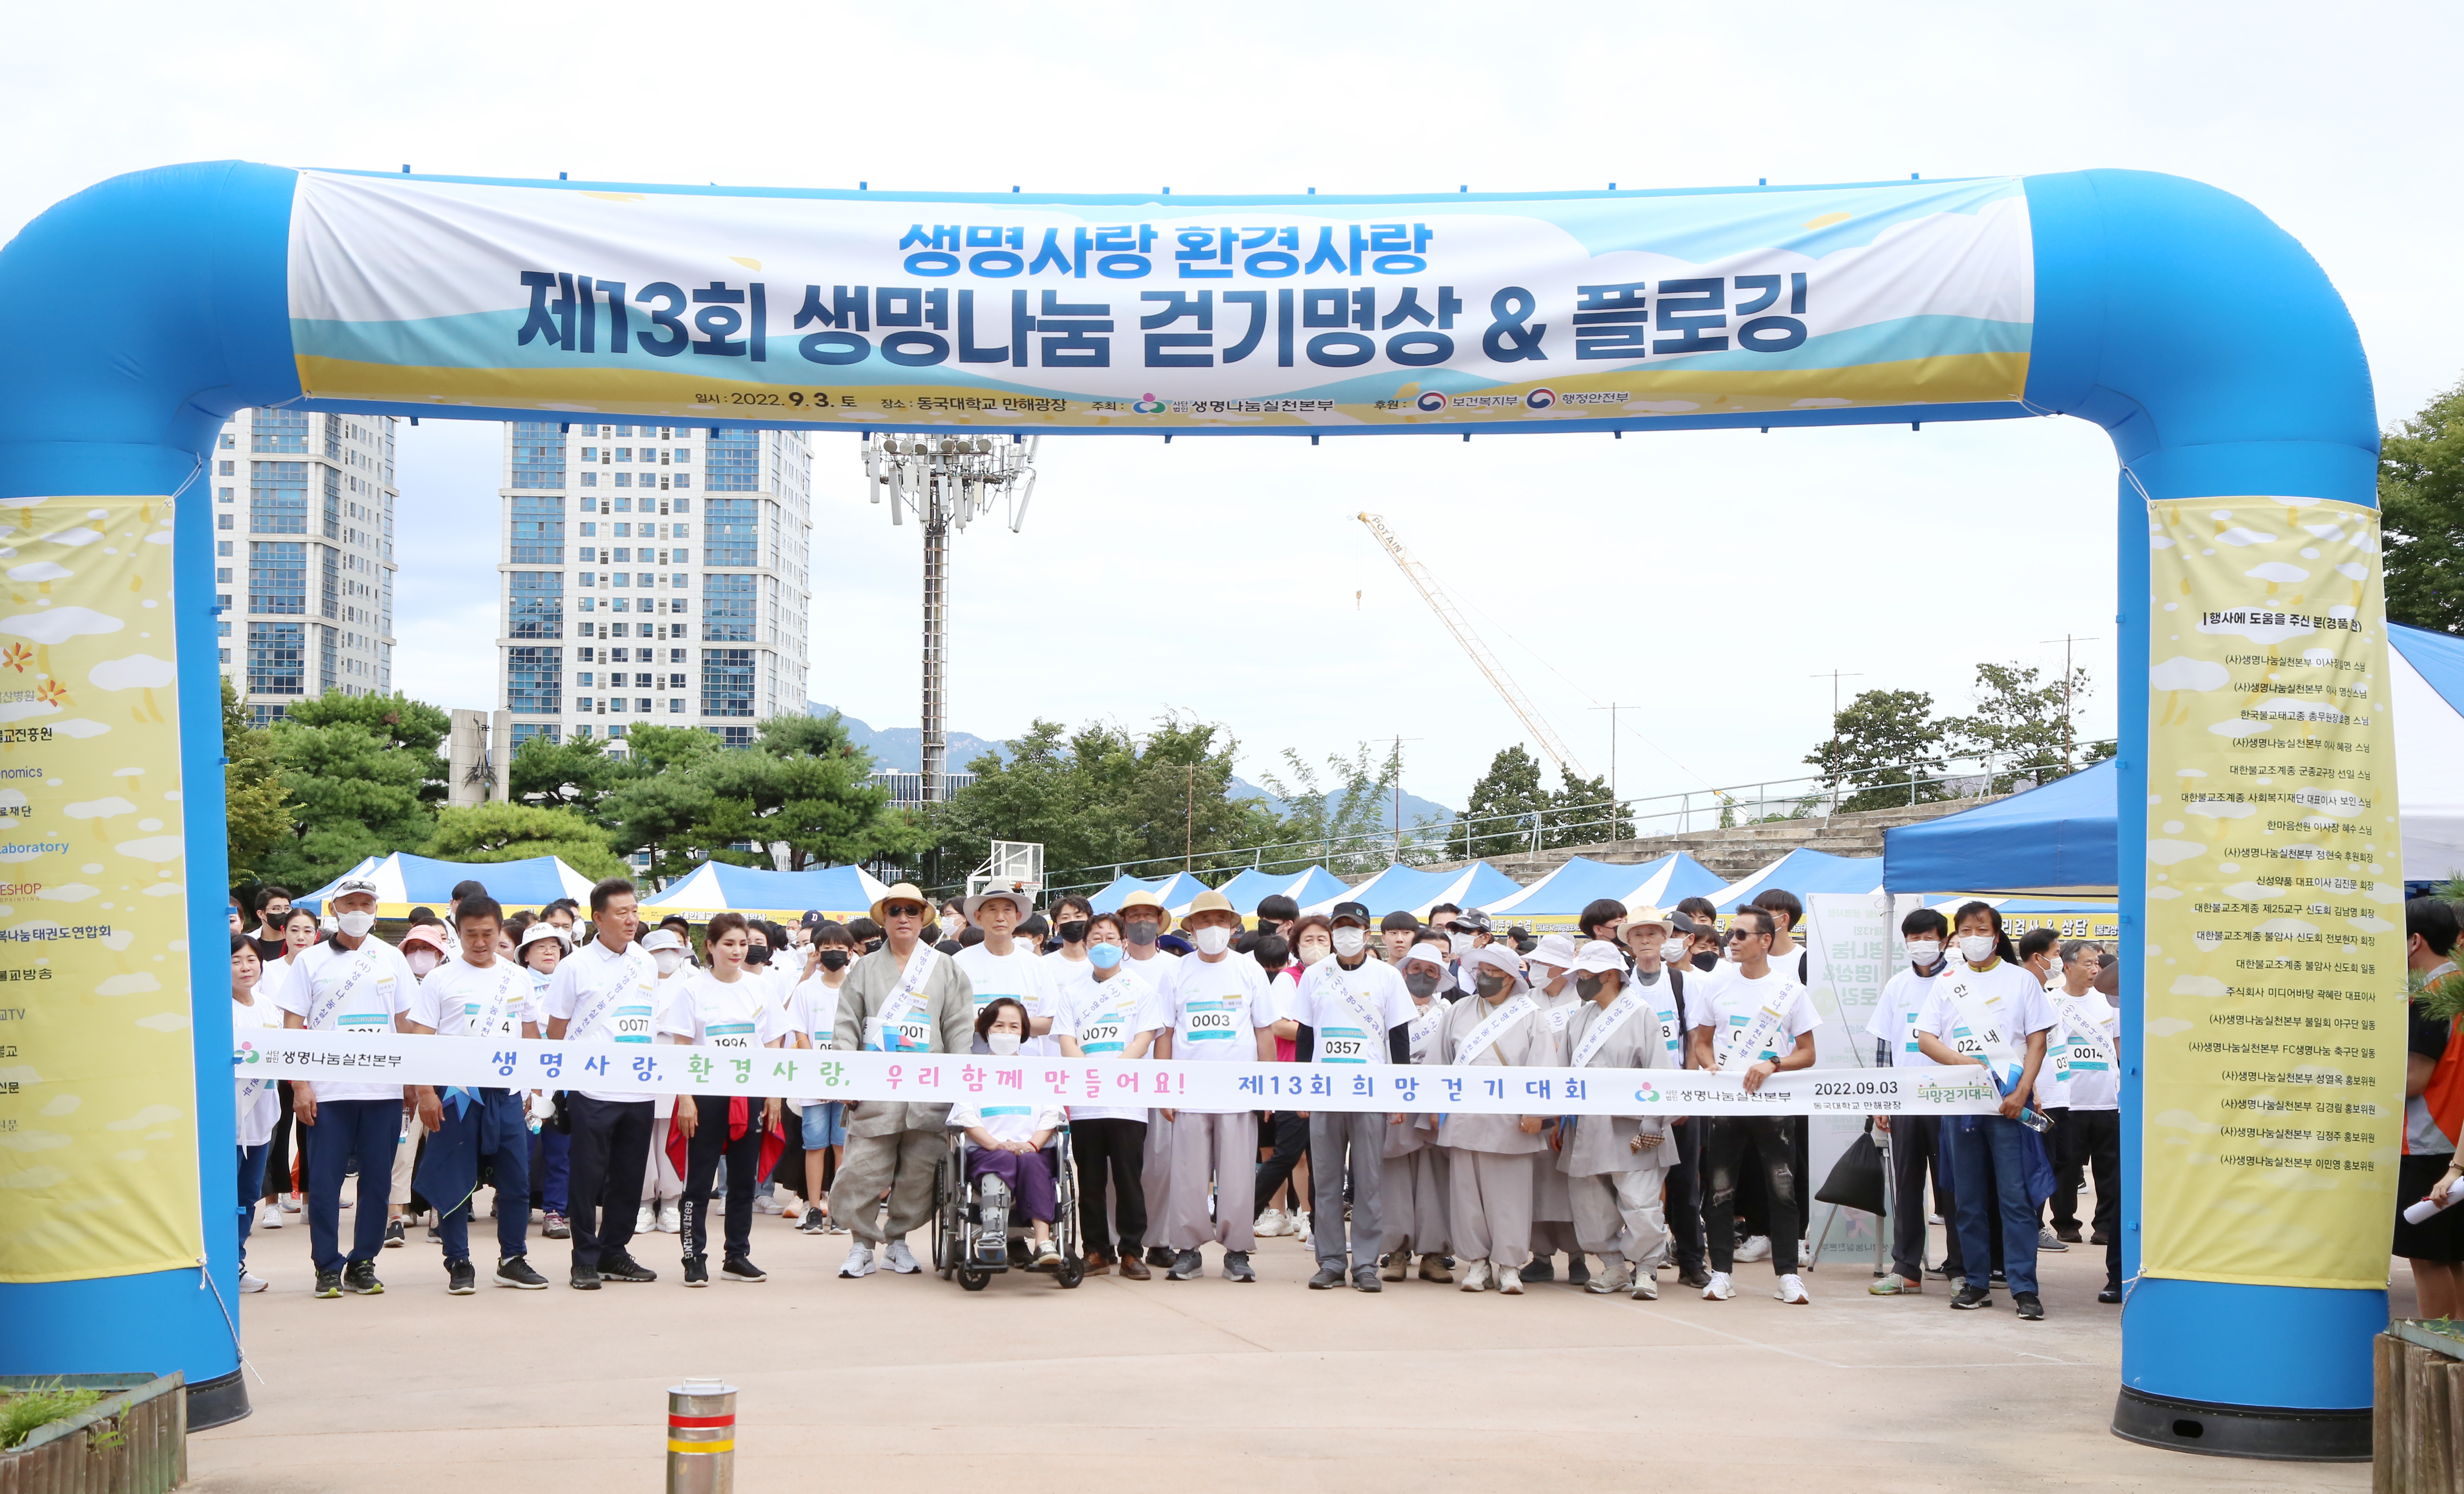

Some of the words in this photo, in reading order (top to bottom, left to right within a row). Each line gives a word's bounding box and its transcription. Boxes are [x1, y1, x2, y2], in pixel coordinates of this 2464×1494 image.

[899, 224, 1158, 279] 생명사랑
[1175, 223, 1433, 279] 환경사랑
[517, 270, 766, 362] 제13회
[793, 285, 1114, 368] 생명나눔
[1140, 286, 1463, 368] 걷기명상
[1482, 286, 1549, 363] &
[1572, 272, 1807, 360] 플로깅
[842, 396, 857, 407] 토
[917, 397, 998, 411] 동국대학교
[1002, 398, 1067, 412] 만해광장
[1192, 400, 1333, 413] 생명나눔실천본부
[1452, 396, 1517, 407] 보건복지부
[1562, 393, 1628, 404] 행정안전부
[1372, 517, 1403, 553] POTAIN
[2210, 612, 2246, 624] 행사에
[2250, 613, 2286, 625] 도움을
[2289, 614, 2310, 627] 주신
[2313, 616, 2348, 630] 분(경품
[2225, 654, 2312, 667] (사)생명나눔실천본부
[2316, 658, 2340, 669] 이사장
[2354, 662, 2365, 672] 스님
[0, 690, 35, 704] 산병원
[2234, 682, 2323, 694] (사)생명나눔실천본부
[2326, 685, 2337, 696] 이사
[2339, 687, 2352, 698] 명신
[2352, 689, 2367, 699] 스님
[2241, 710, 2305, 721] 한국불교태고종
[2308, 711, 2338, 723] 총무원장
[2353, 716, 2369, 726] 스님
[2233, 737, 2322, 749] (사)생명나눔실천본부
[2324, 740, 2335, 751] 이사
[2337, 742, 2352, 752] 혜광
[2355, 743, 2369, 754] 스님
[1, 766, 43, 779] nomics
[2230, 765, 2296, 776] 대한불교조계종
[2299, 766, 2335, 779] 군종교구장
[2337, 769, 2355, 779] 선일
[2357, 770, 2370, 781] 스님
[2181, 793, 2245, 803] 대한불교조계종
[2248, 793, 2305, 804] 사회복지재단
[2307, 795, 2337, 806] 대표이사
[2340, 796, 2356, 806] 보인
[2358, 798, 2371, 808] 스님
[2267, 820, 2311, 832] 한마음선원
[2314, 823, 2340, 833] 이사장
[2359, 826, 2372, 836] 스님
[2224, 847, 2313, 859] (사)생명나눔실천본부
[2316, 850, 2342, 861] 정현숙
[2344, 851, 2373, 863] 후원회장
[2256, 876, 2292, 886] 신성약품
[2296, 877, 2332, 888] 대표이사
[2334, 879, 2357, 890] 김진문
[2360, 880, 2374, 891] 회장
[812, 913, 818, 921] D
[2195, 903, 2260, 913] 대한불교조계종
[2263, 904, 2303, 914] 제25교구
[2306, 905, 2331, 916] 신도회
[2334, 907, 2357, 917] 김남명
[2360, 908, 2375, 919] 회장
[2197, 931, 2261, 942] 대한불교조계종
[2264, 932, 2293, 942] 불암사
[2296, 933, 2323, 943] 신도회
[2360, 936, 2375, 947] 회장
[2236, 959, 2302, 971] 대한불교조계종
[2305, 961, 2332, 972] 불암사
[2334, 963, 2358, 973] 신도회
[2361, 964, 2375, 975] 일동
[2226, 987, 2265, 997] 주식회사
[2268, 988, 2315, 999] 미디어바탕
[2317, 990, 2342, 1000] 곽혜란
[2345, 991, 2376, 1002] 대표이사
[619, 1019, 648, 1032] 0077
[1192, 1014, 1230, 1027] 0003
[2210, 1014, 2302, 1026] (사)생명나눔실천본부
[2305, 1017, 2331, 1028] 불일회
[2334, 1018, 2359, 1029] 야구단
[2361, 1020, 2376, 1031] 일동
[1083, 1026, 1118, 1041] 0079
[1326, 1041, 1360, 1054] 0357
[2074, 1048, 2103, 1059] 0014
[2189, 1042, 2279, 1054] (사)생명나눔실천본부
[2283, 1044, 2331, 1056] FC생명나눔
[2334, 1046, 2359, 1058] 축구단
[2361, 1048, 2376, 1059] 일동
[282, 1051, 401, 1067] 생명나눔실천본부
[886, 1065, 938, 1090] 우리
[961, 1063, 1023, 1092] 함께
[1045, 1068, 1184, 1099] 만들어요!
[2222, 1071, 2313, 1084] (사)생명나눔실천본부
[2316, 1074, 2343, 1085] 성열옥
[2345, 1075, 2375, 1087] 홍보위원
[1680, 1088, 1791, 1102] 생명나눔실천본부
[1815, 1081, 1898, 1095] 2022.09.03
[1813, 1102, 1860, 1110] 동국대학교
[1864, 1101, 1902, 1110] 만해광장
[2221, 1099, 2312, 1112] (사)생명나눔실천본부
[2316, 1102, 2342, 1113] 김경림
[2345, 1103, 2375, 1115] 홍보위원
[2220, 1126, 2312, 1140] (사)생명나눔실천본부
[2316, 1131, 2342, 1141] 김정주
[2344, 1131, 2374, 1143] 홍보위원
[2220, 1154, 2313, 1168] (사)생명나눔실천본부
[2316, 1159, 2340, 1170] 이민영
[2343, 1160, 2374, 1172] 홍보위원
